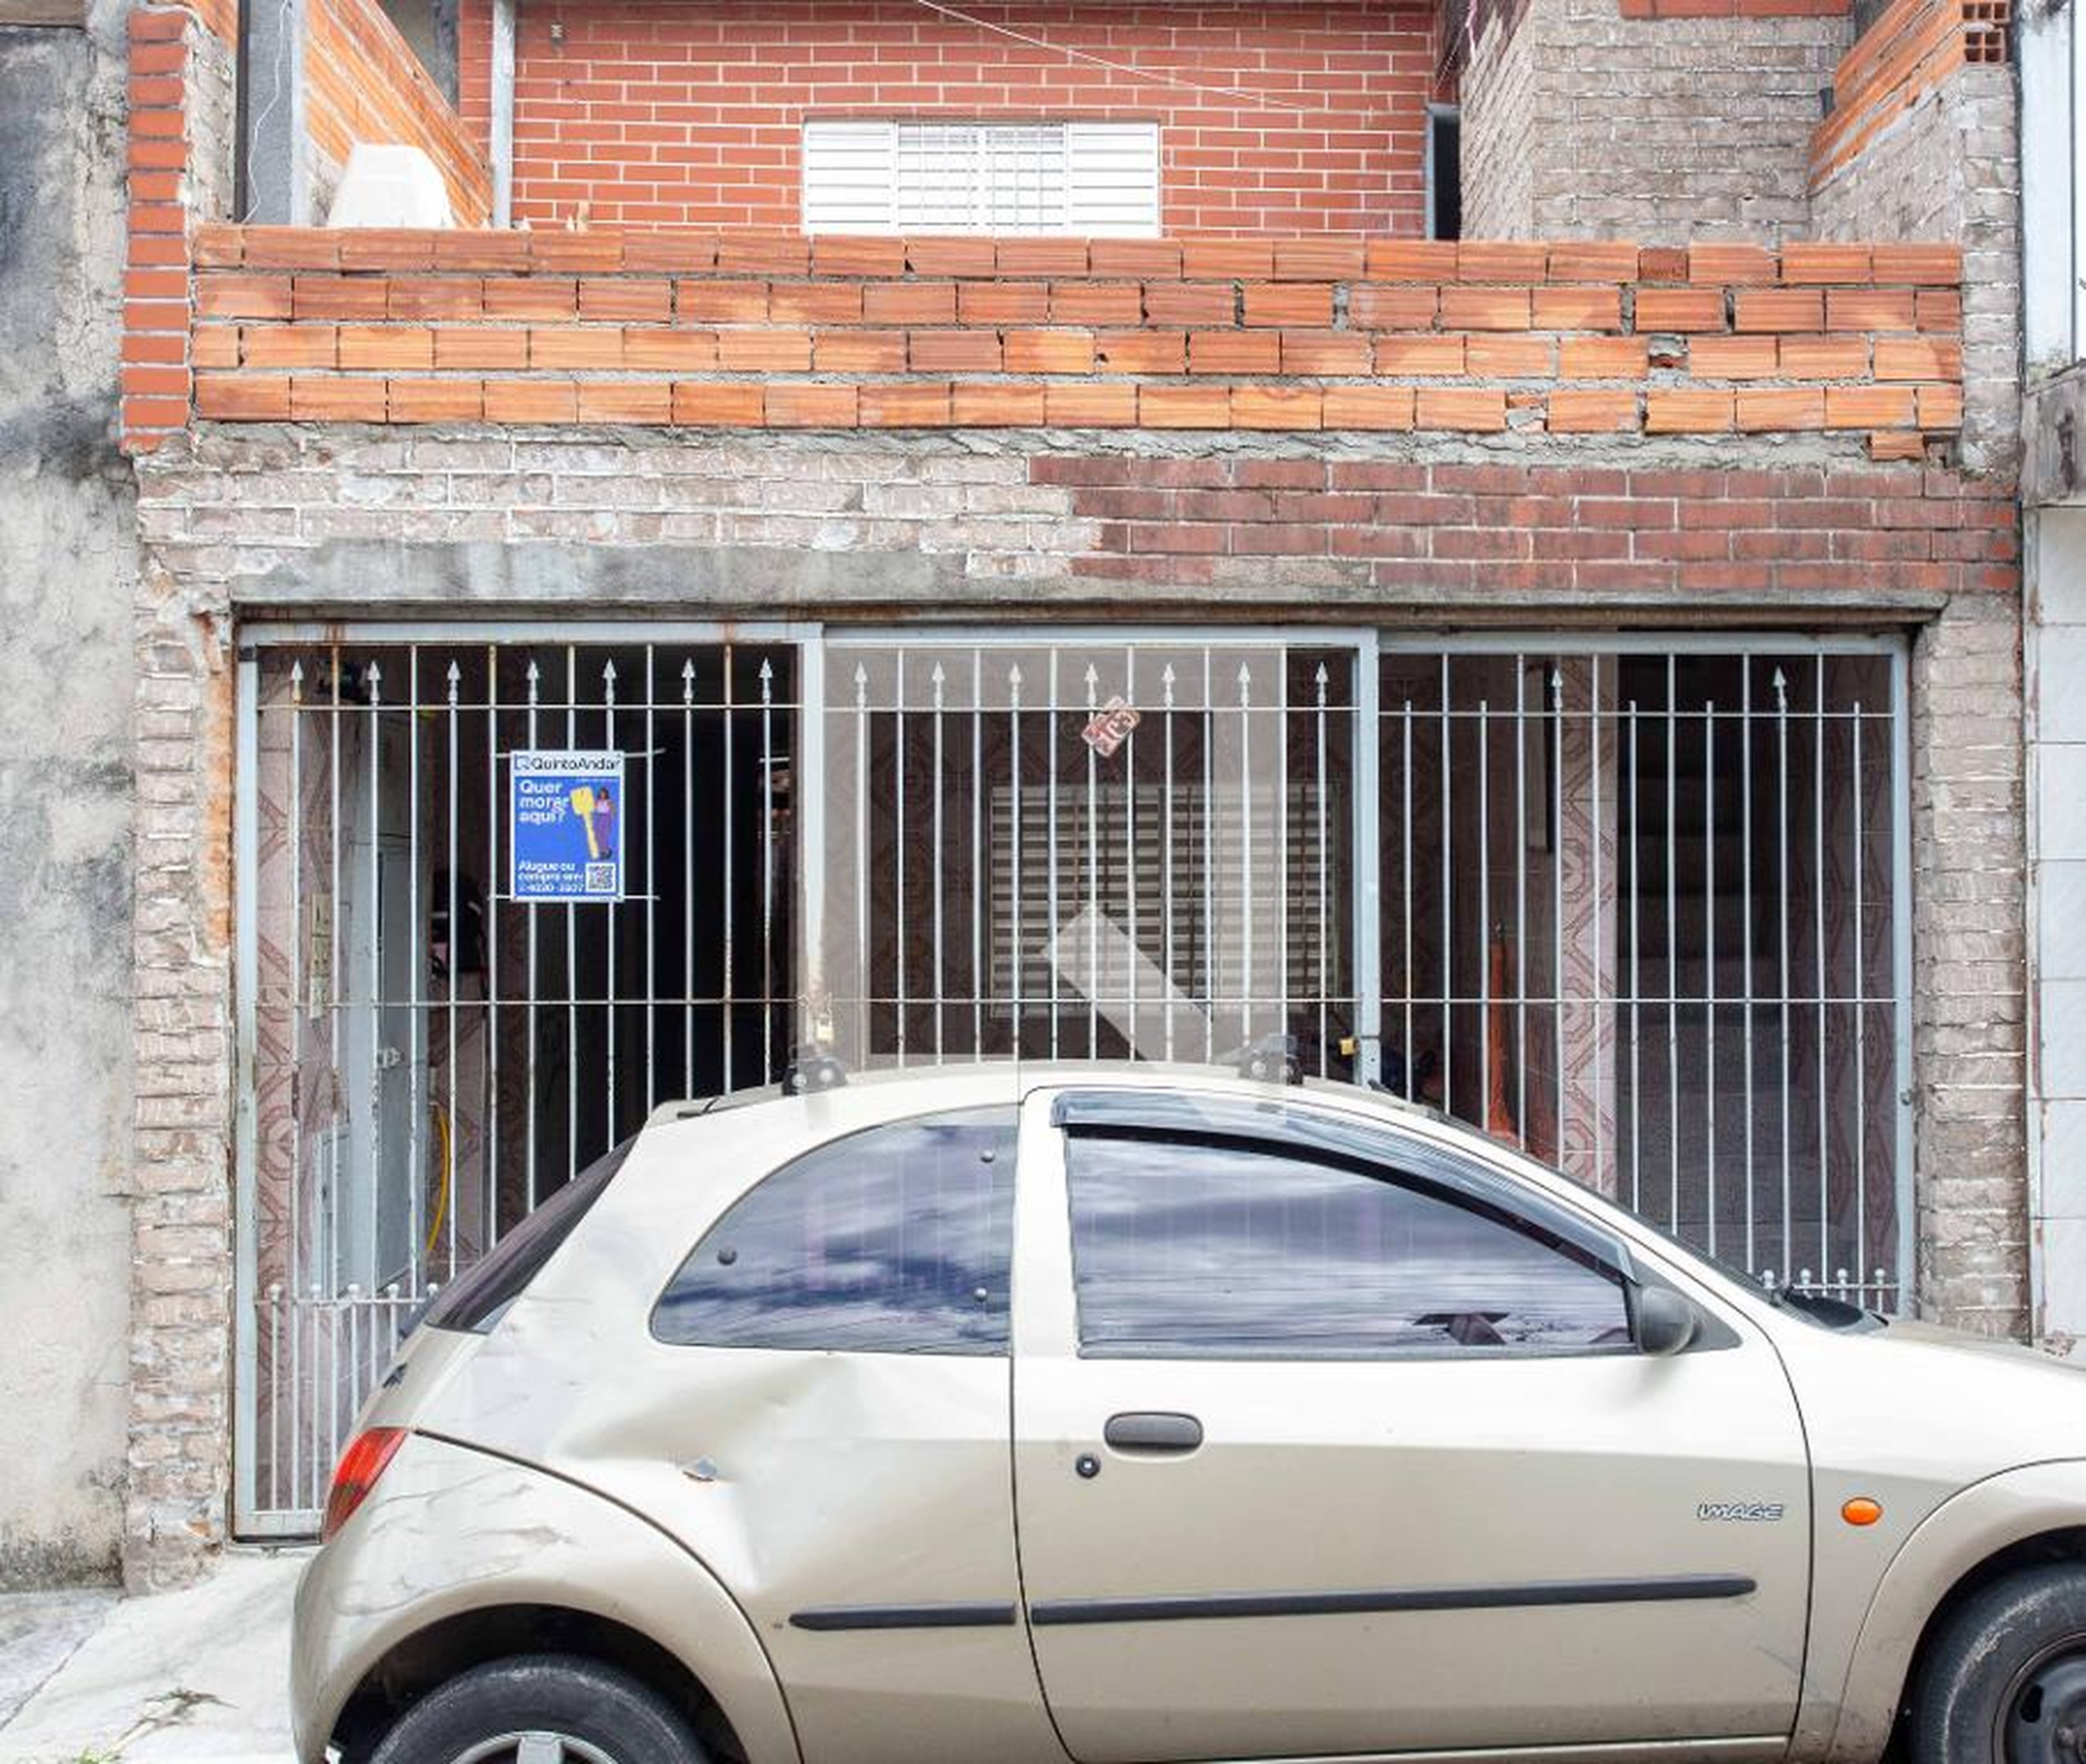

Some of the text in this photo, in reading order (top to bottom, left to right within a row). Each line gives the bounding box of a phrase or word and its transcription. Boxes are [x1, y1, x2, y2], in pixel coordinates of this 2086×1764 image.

[531, 757, 621, 770] QuintoAndar
[520, 780, 563, 794] Quer
[520, 797, 569, 808] morar
[519, 810, 566, 824] aqui?
[1698, 1504, 1783, 1521] IMAGE
